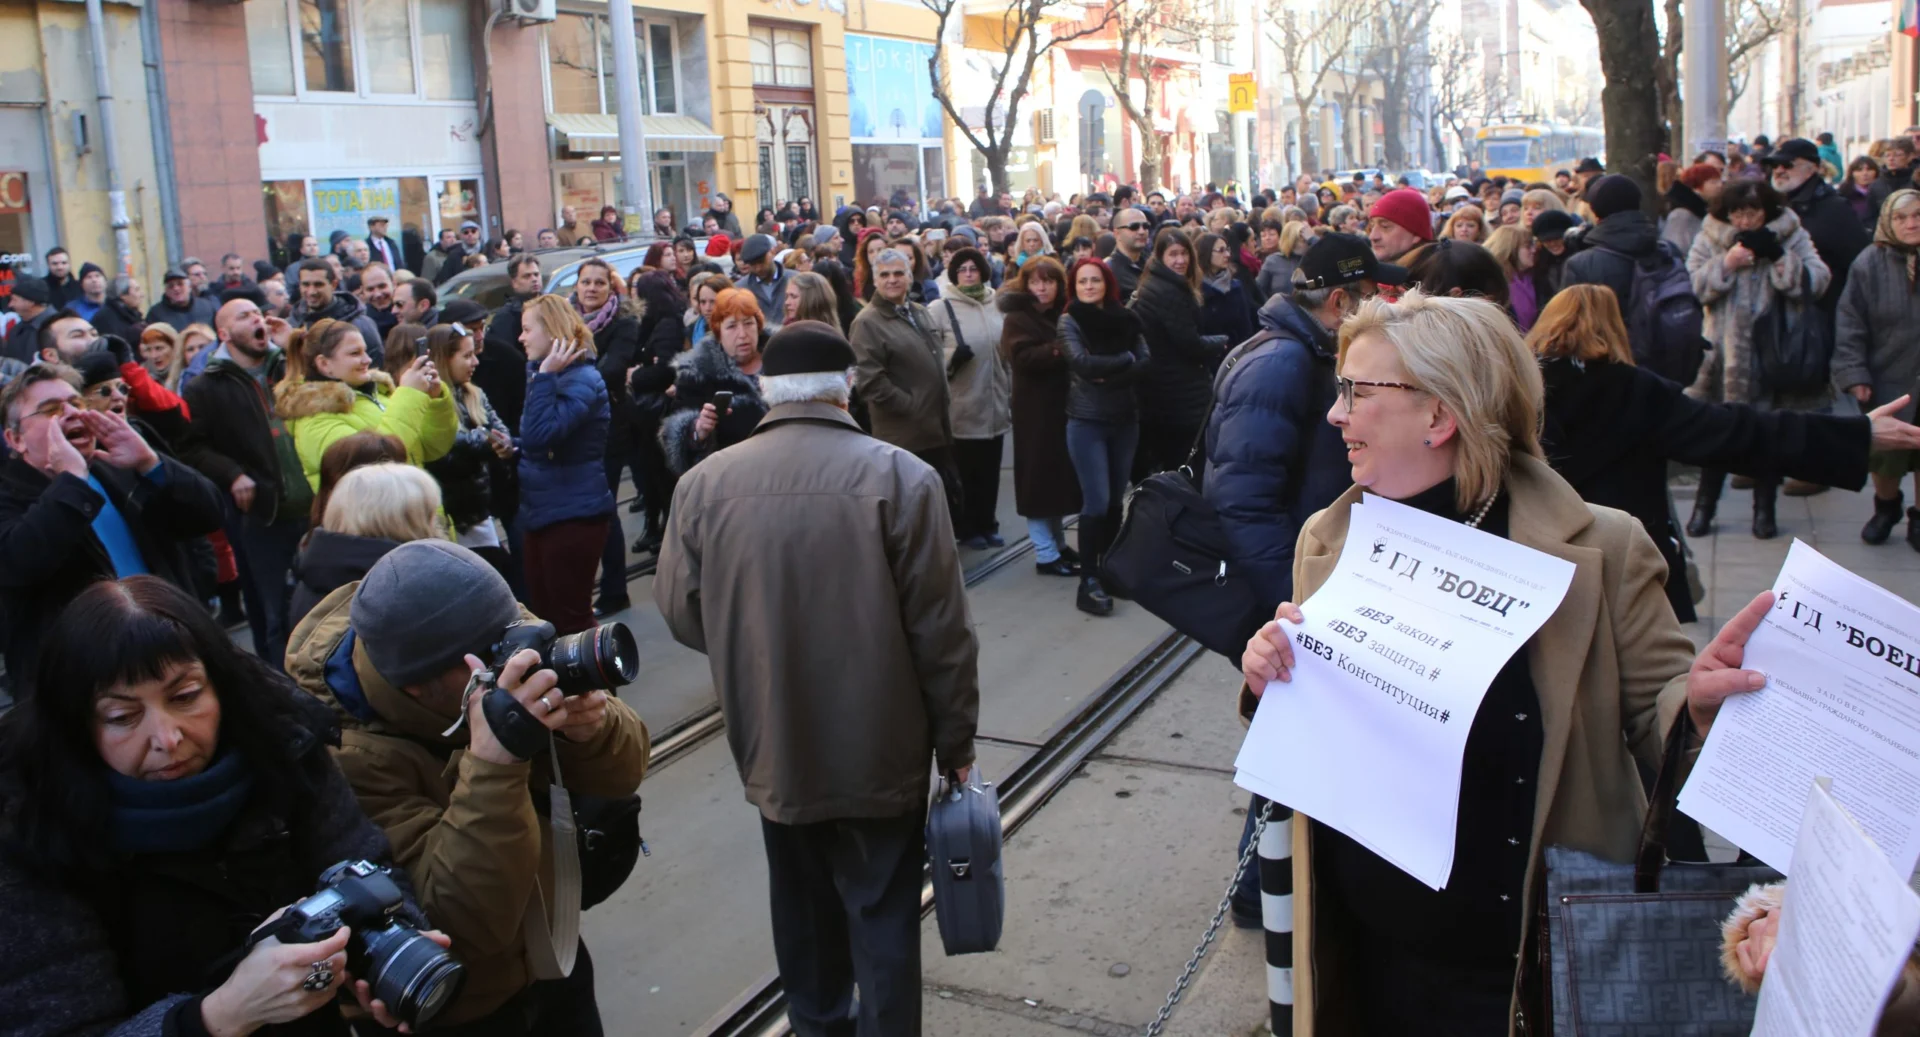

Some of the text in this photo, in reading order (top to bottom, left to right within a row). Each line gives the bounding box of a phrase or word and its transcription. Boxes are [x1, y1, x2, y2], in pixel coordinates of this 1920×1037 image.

[314, 188, 396, 213] ТОТАЛНА
[1388, 551, 1422, 581] ГД
[1353, 605, 1394, 625] #БЕЗ
[1393, 621, 1439, 647] закон
[1439, 639, 1454, 652] #
[1792, 600, 1823, 634] ГД
[1296, 631, 1334, 661] #БЕЗ
[1326, 618, 1442, 682] #БЕЗ защита #
[1818, 700, 1870, 733] ГРАЖДАНСКО
